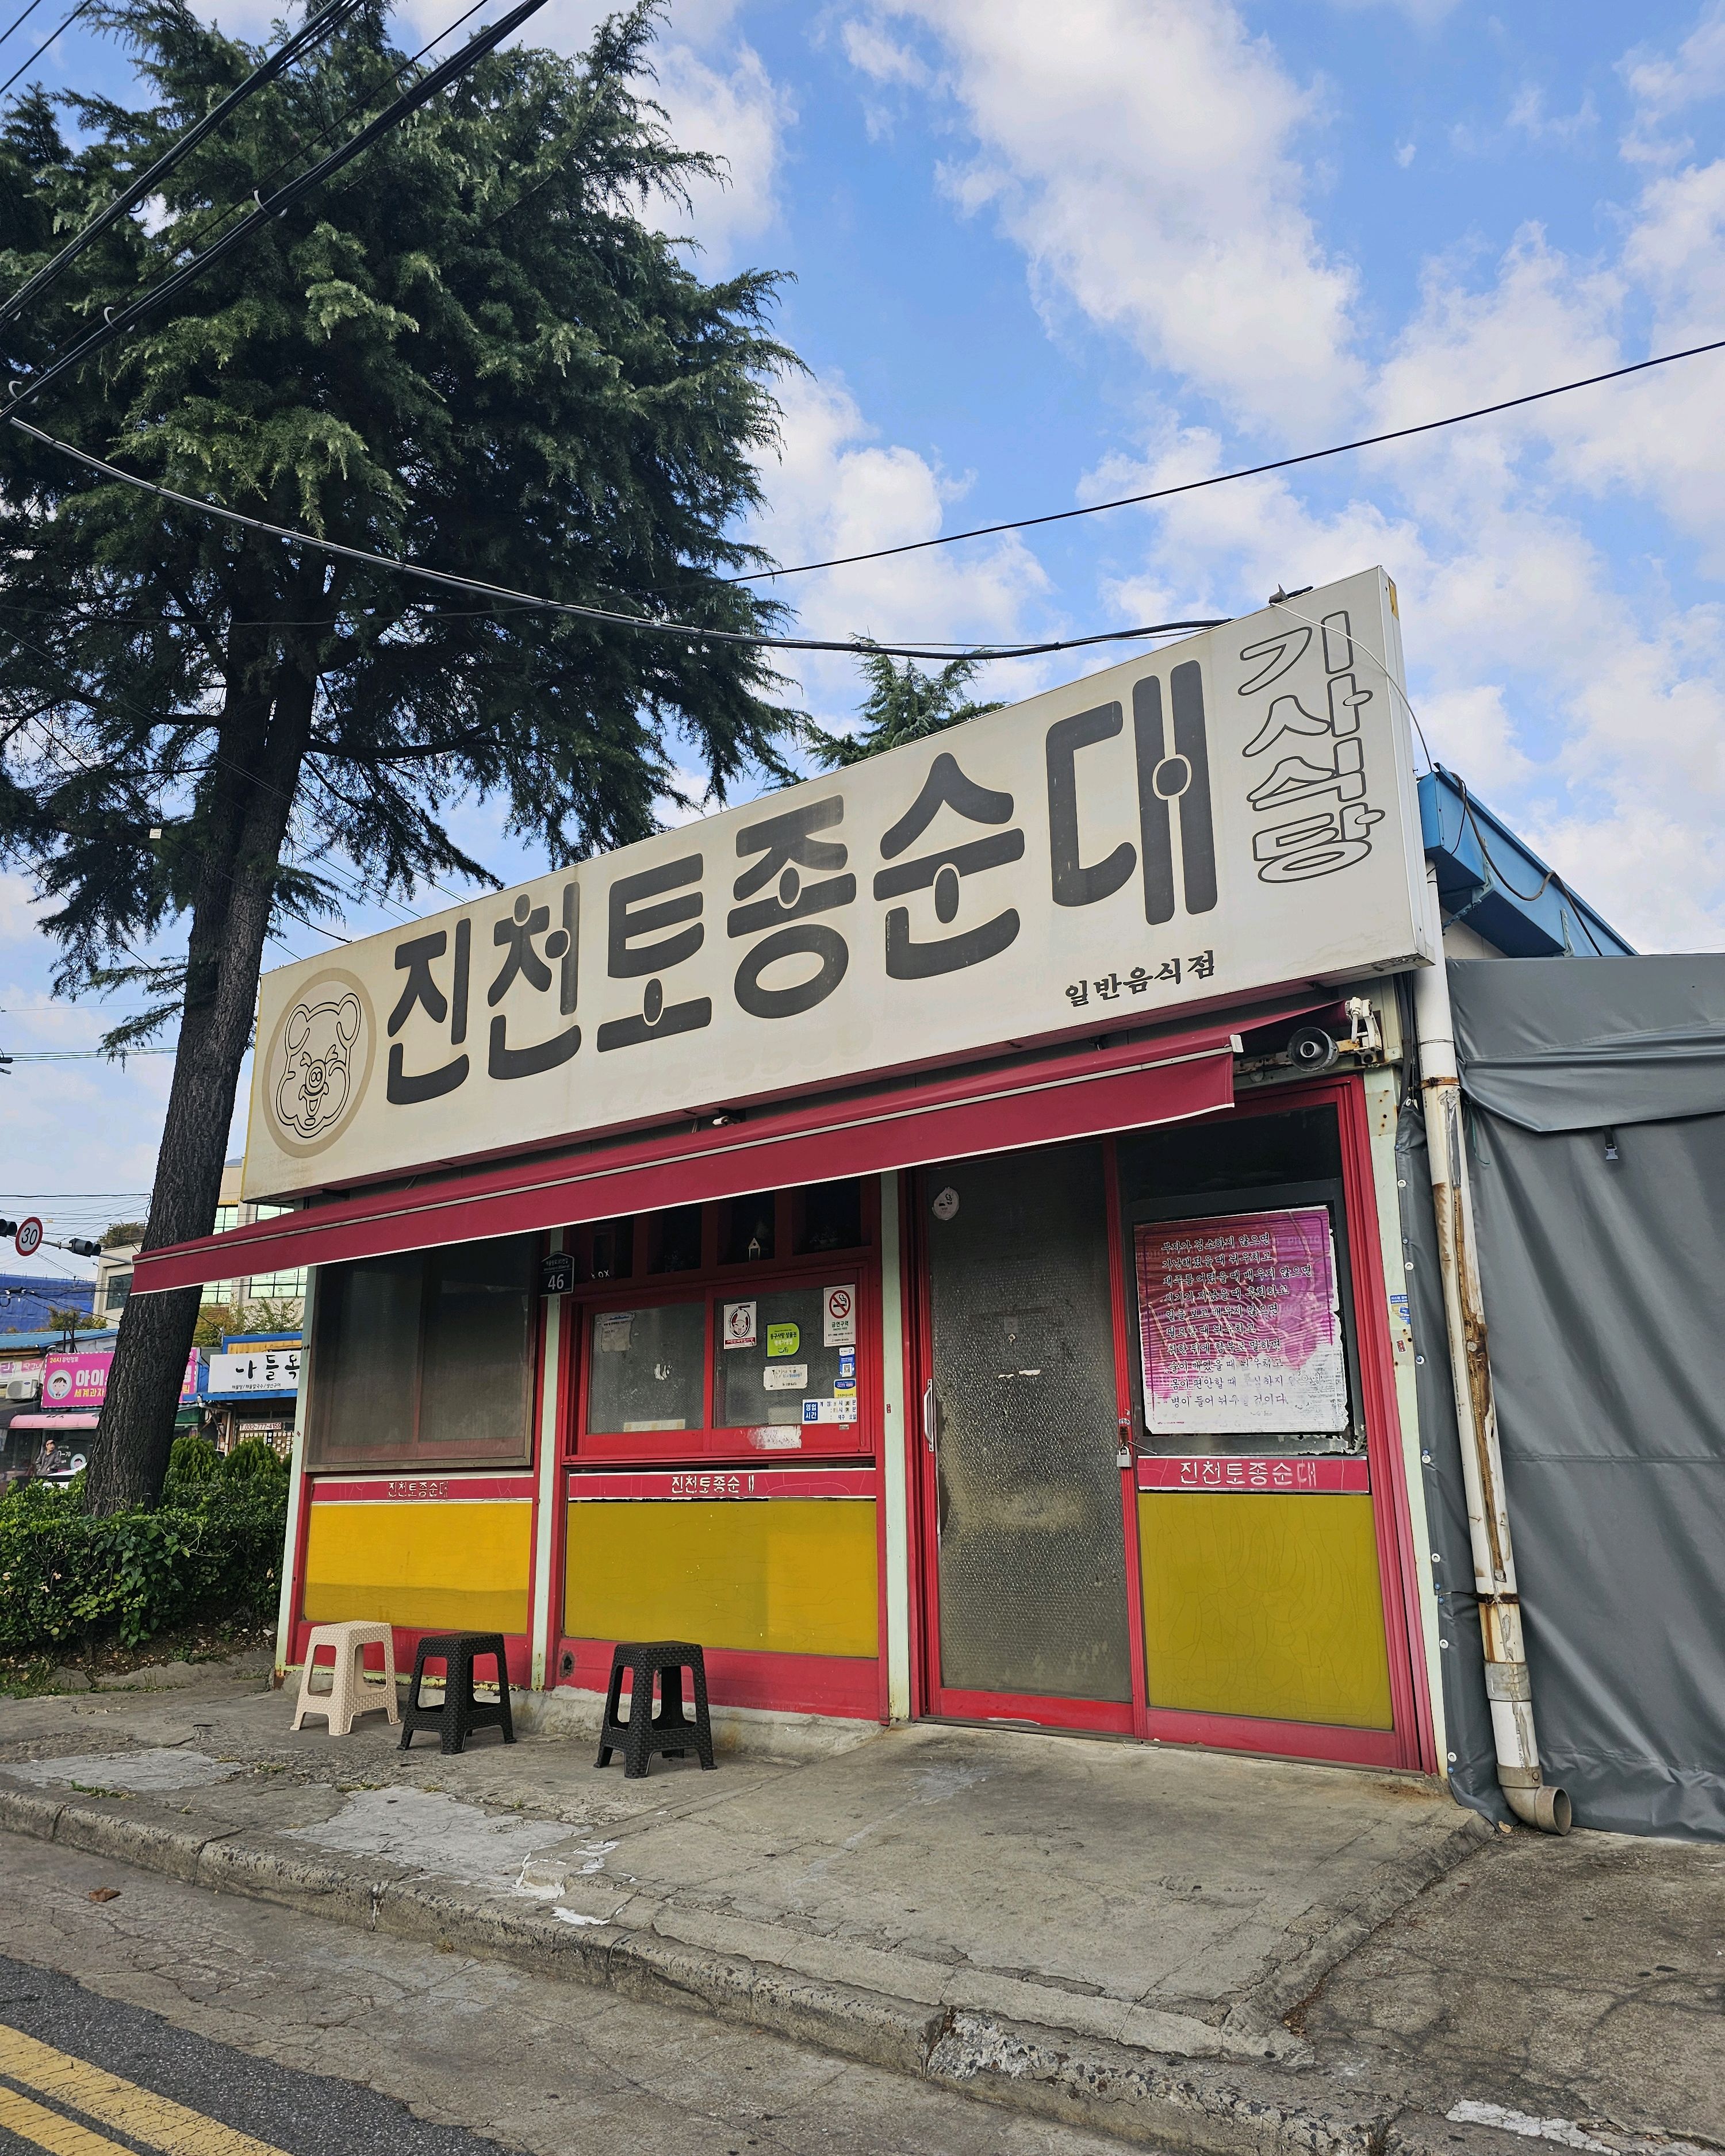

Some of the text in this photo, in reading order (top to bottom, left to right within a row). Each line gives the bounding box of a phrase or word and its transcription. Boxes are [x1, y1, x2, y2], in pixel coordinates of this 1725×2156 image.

[1238, 611, 1385, 883] 기사식당
[387, 660, 1217, 1105] 진천토종순대
[1065, 949, 1215, 1007] 일반음식점
[21, 1227, 38, 1245] 30
[1162, 1232, 1270, 1254] 부자가 검소하지 않으면
[1216, 1253, 1225, 1267] 때
[548, 1274, 564, 1290] 46
[1163, 1264, 1312, 1288] 재주를 어렸을 때 배우지 않으면
[1164, 1284, 1289, 1305] 시기가 지났을 때 후회하고
[1166, 1302, 1278, 1321] 일을 보고 배우지 않으면
[1166, 1325, 1197, 1338] 필요할
[1199, 1324, 1209, 1337] 때
[1168, 1338, 1281, 1355] 취한 뒤에 함부로 말하면
[1170, 1360, 1187, 1374] 술이
[1226, 1359, 1235, 1370] 때
[76, 1369, 108, 1387] 아이
[1170, 1378, 1189, 1390] 몸이
[1194, 1377, 1224, 1389] 편안할
[74, 1388, 105, 1398] 세계과자
[1171, 1395, 1190, 1408] 병이
[1195, 1395, 1213, 1407] 들어
[1180, 1460, 1316, 1487] 진천토종순대
